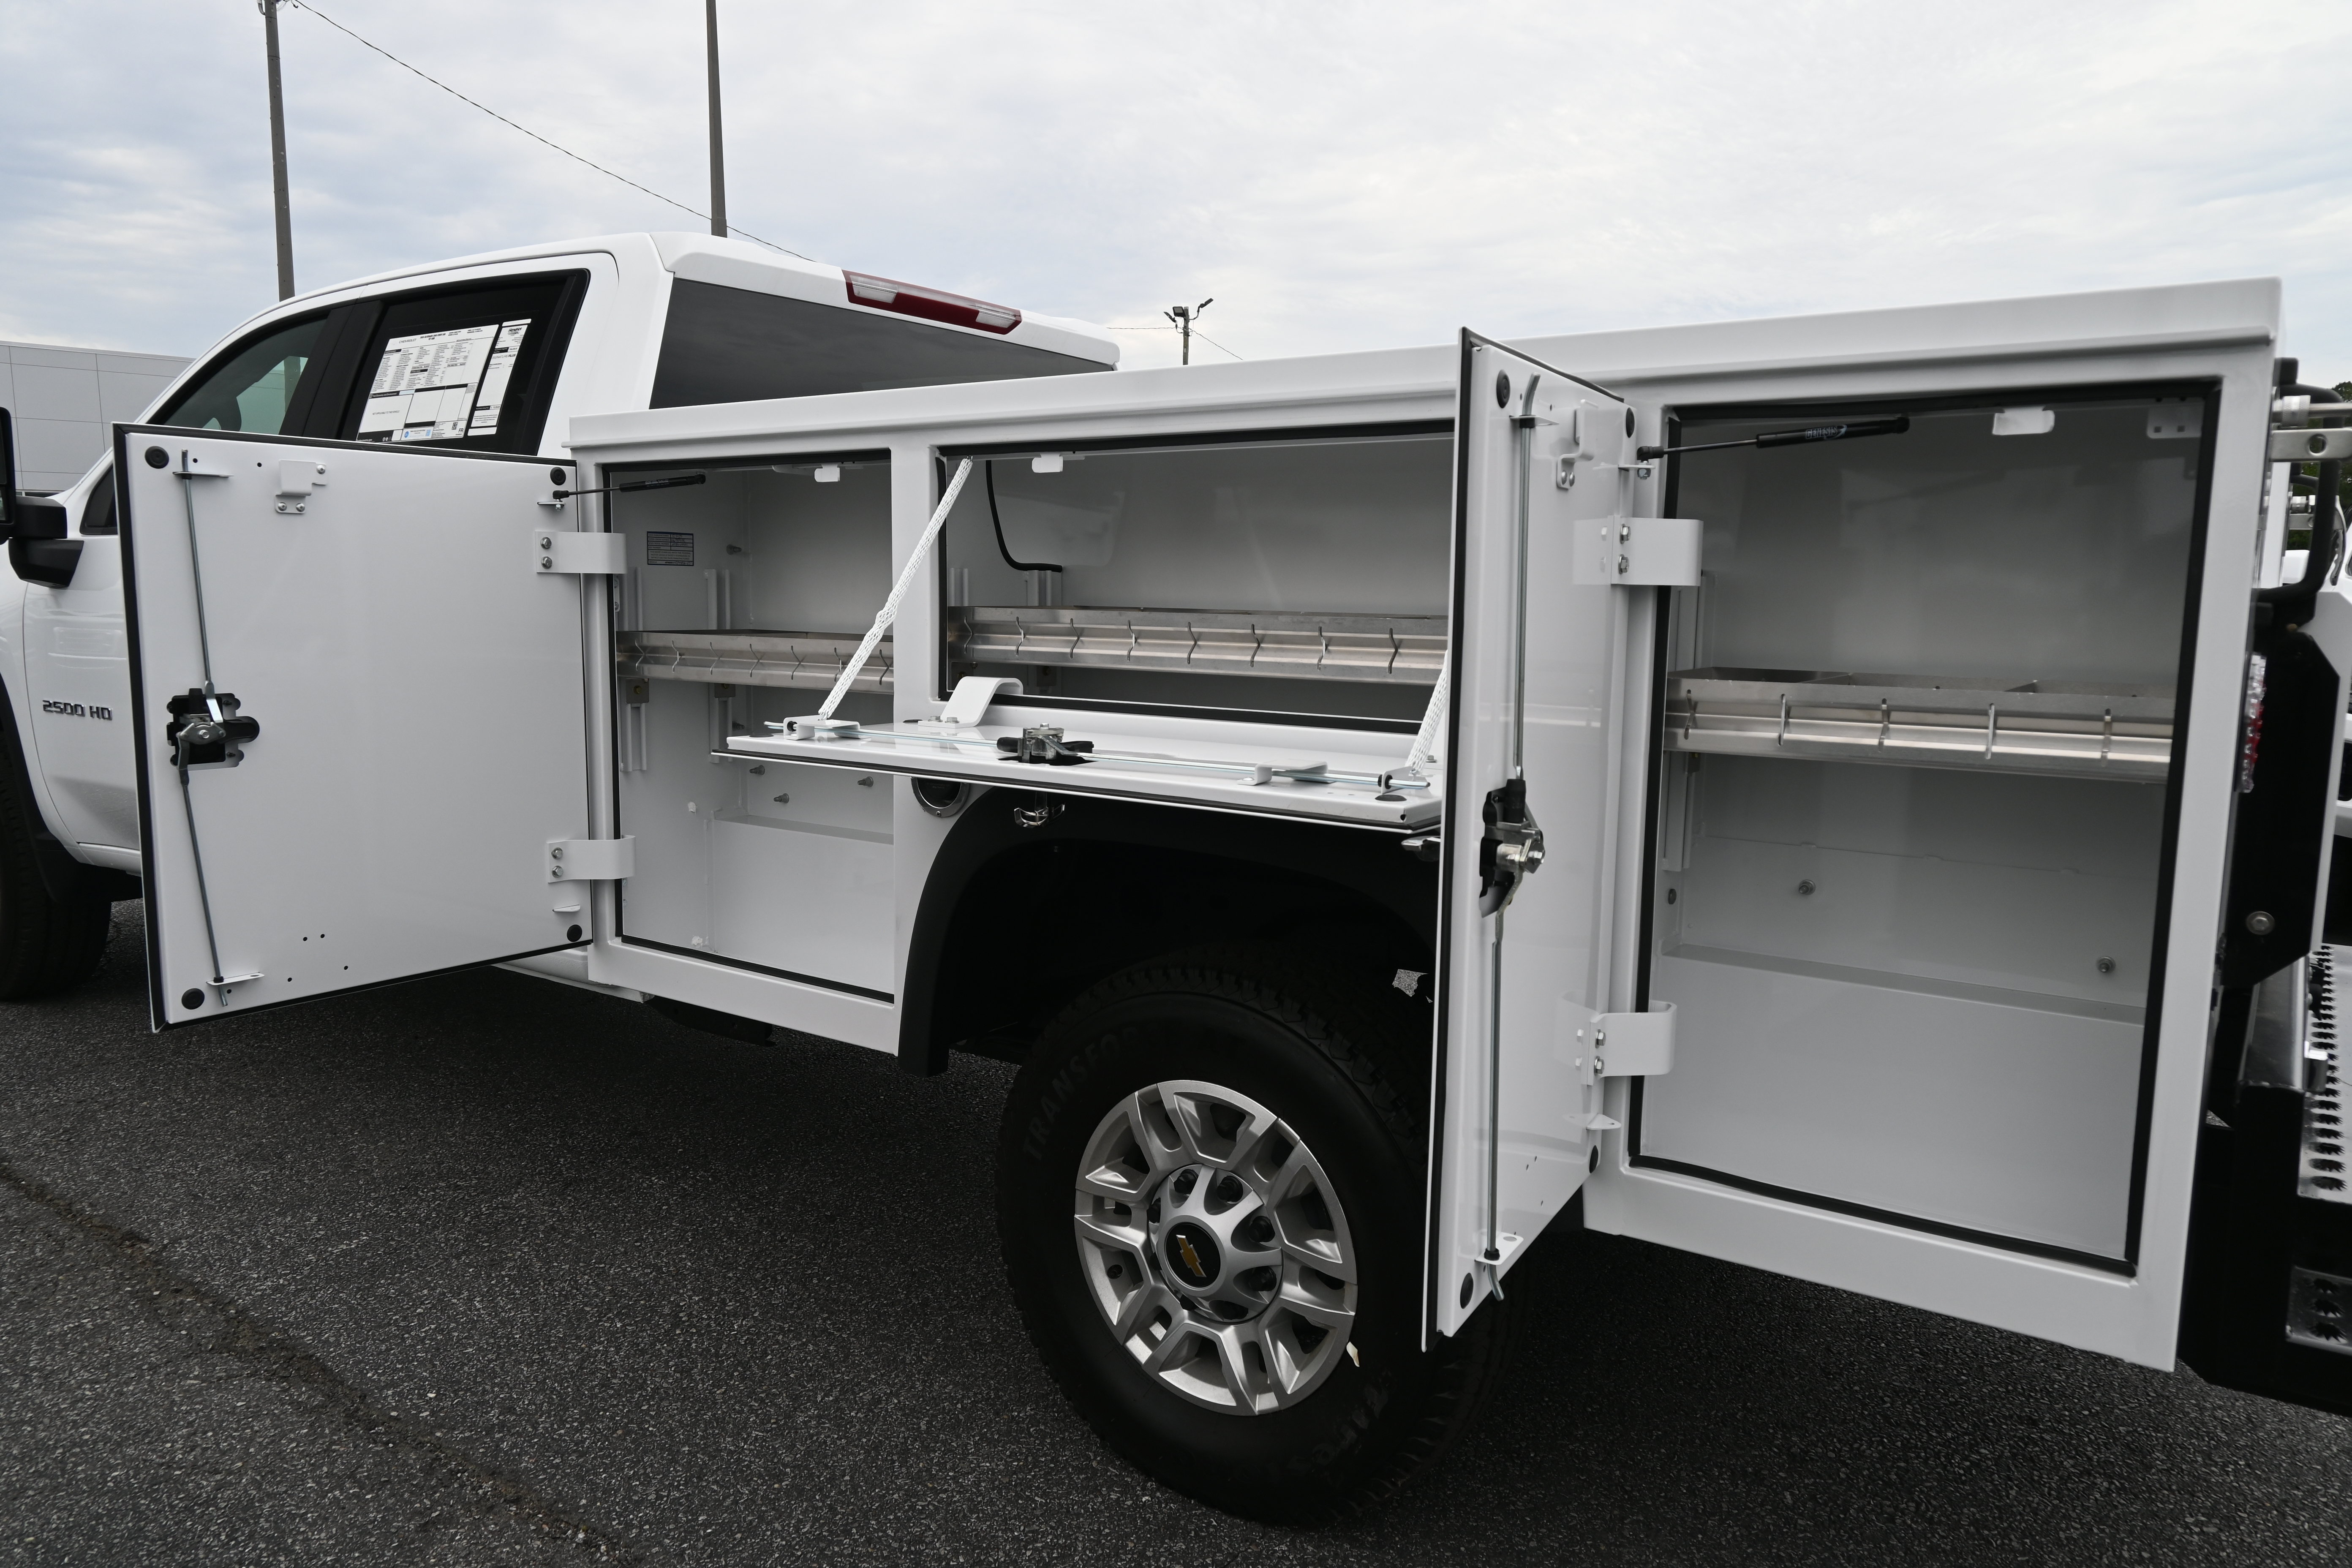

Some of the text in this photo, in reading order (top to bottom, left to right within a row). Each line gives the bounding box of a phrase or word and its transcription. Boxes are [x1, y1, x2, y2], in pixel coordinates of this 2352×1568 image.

[1806, 426, 1838, 439] GENESIS
[42, 700, 113, 721] 2500 HD
